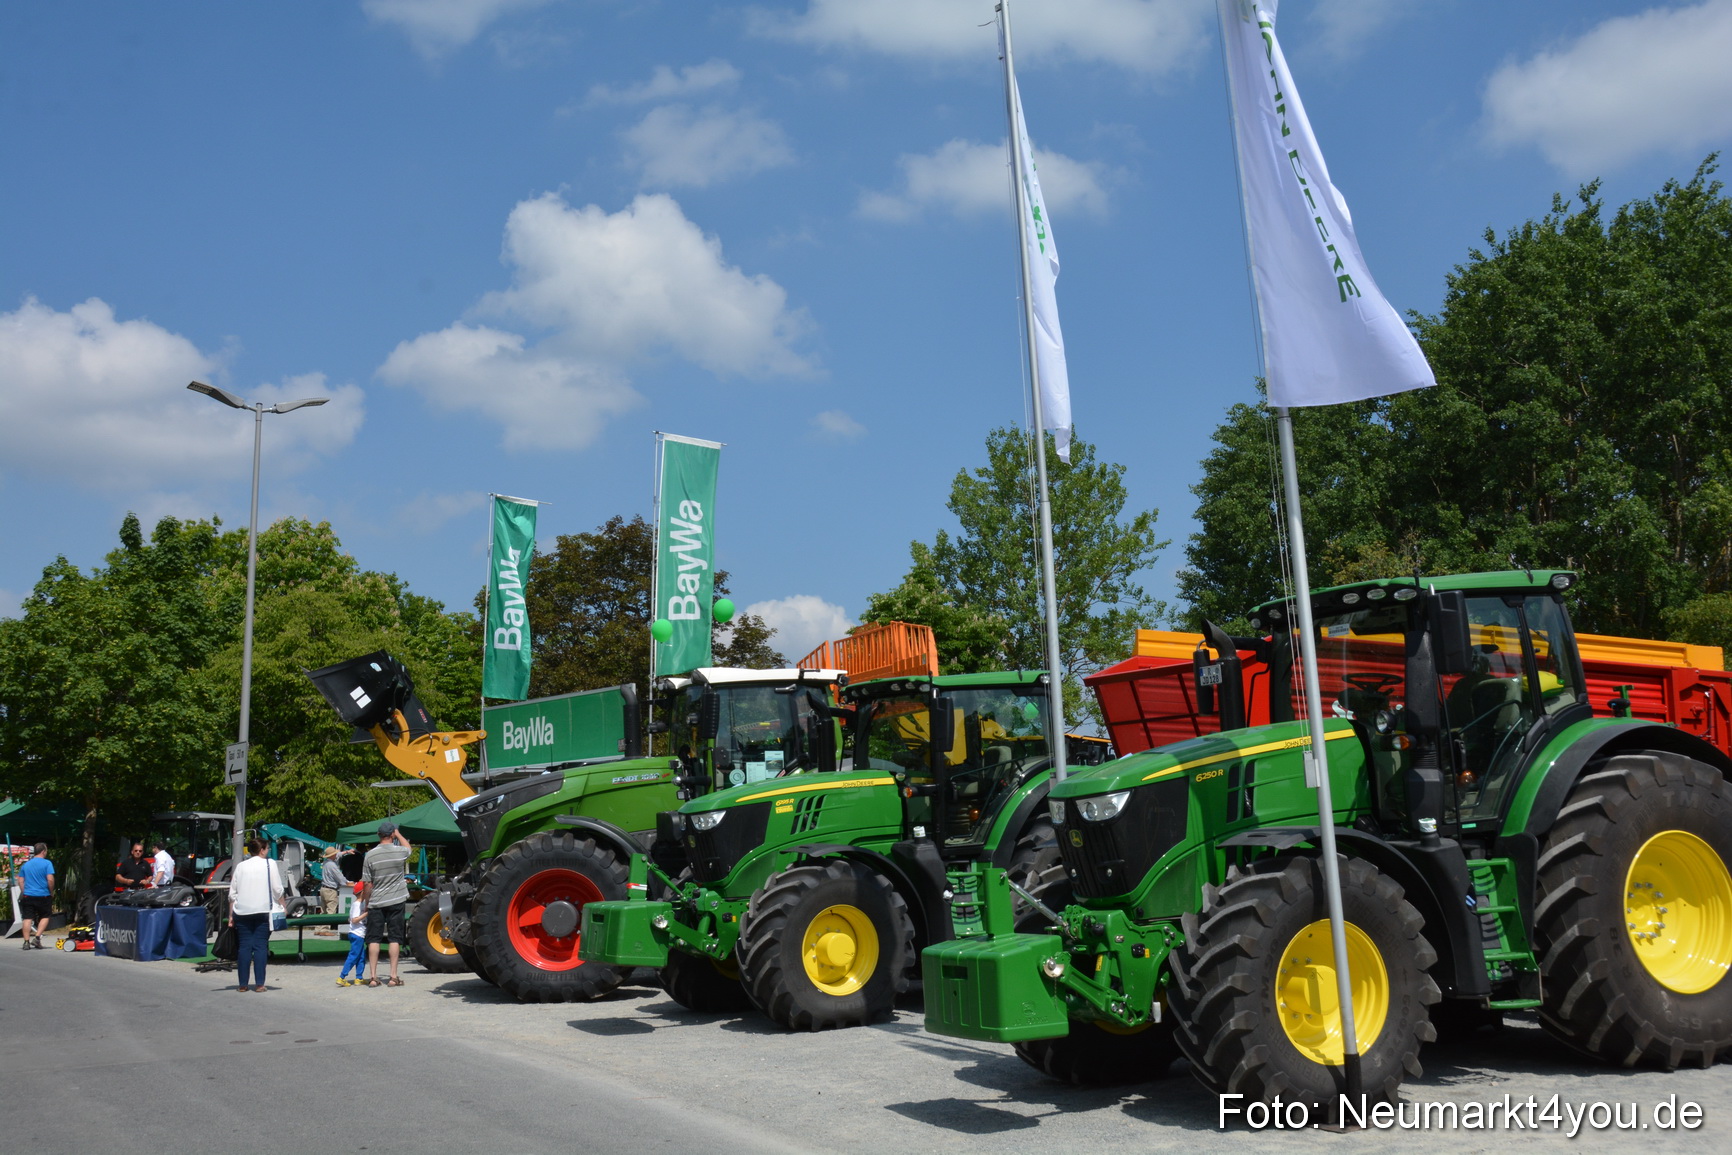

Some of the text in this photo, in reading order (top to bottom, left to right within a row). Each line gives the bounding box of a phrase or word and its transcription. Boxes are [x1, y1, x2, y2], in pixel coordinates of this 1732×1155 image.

[668, 499, 708, 621] BayWa
[494, 546, 524, 651] BayWa
[502, 715, 554, 755] BayWa
[612, 775, 638, 783] FENDT
[1195, 770, 1217, 782] 6250
